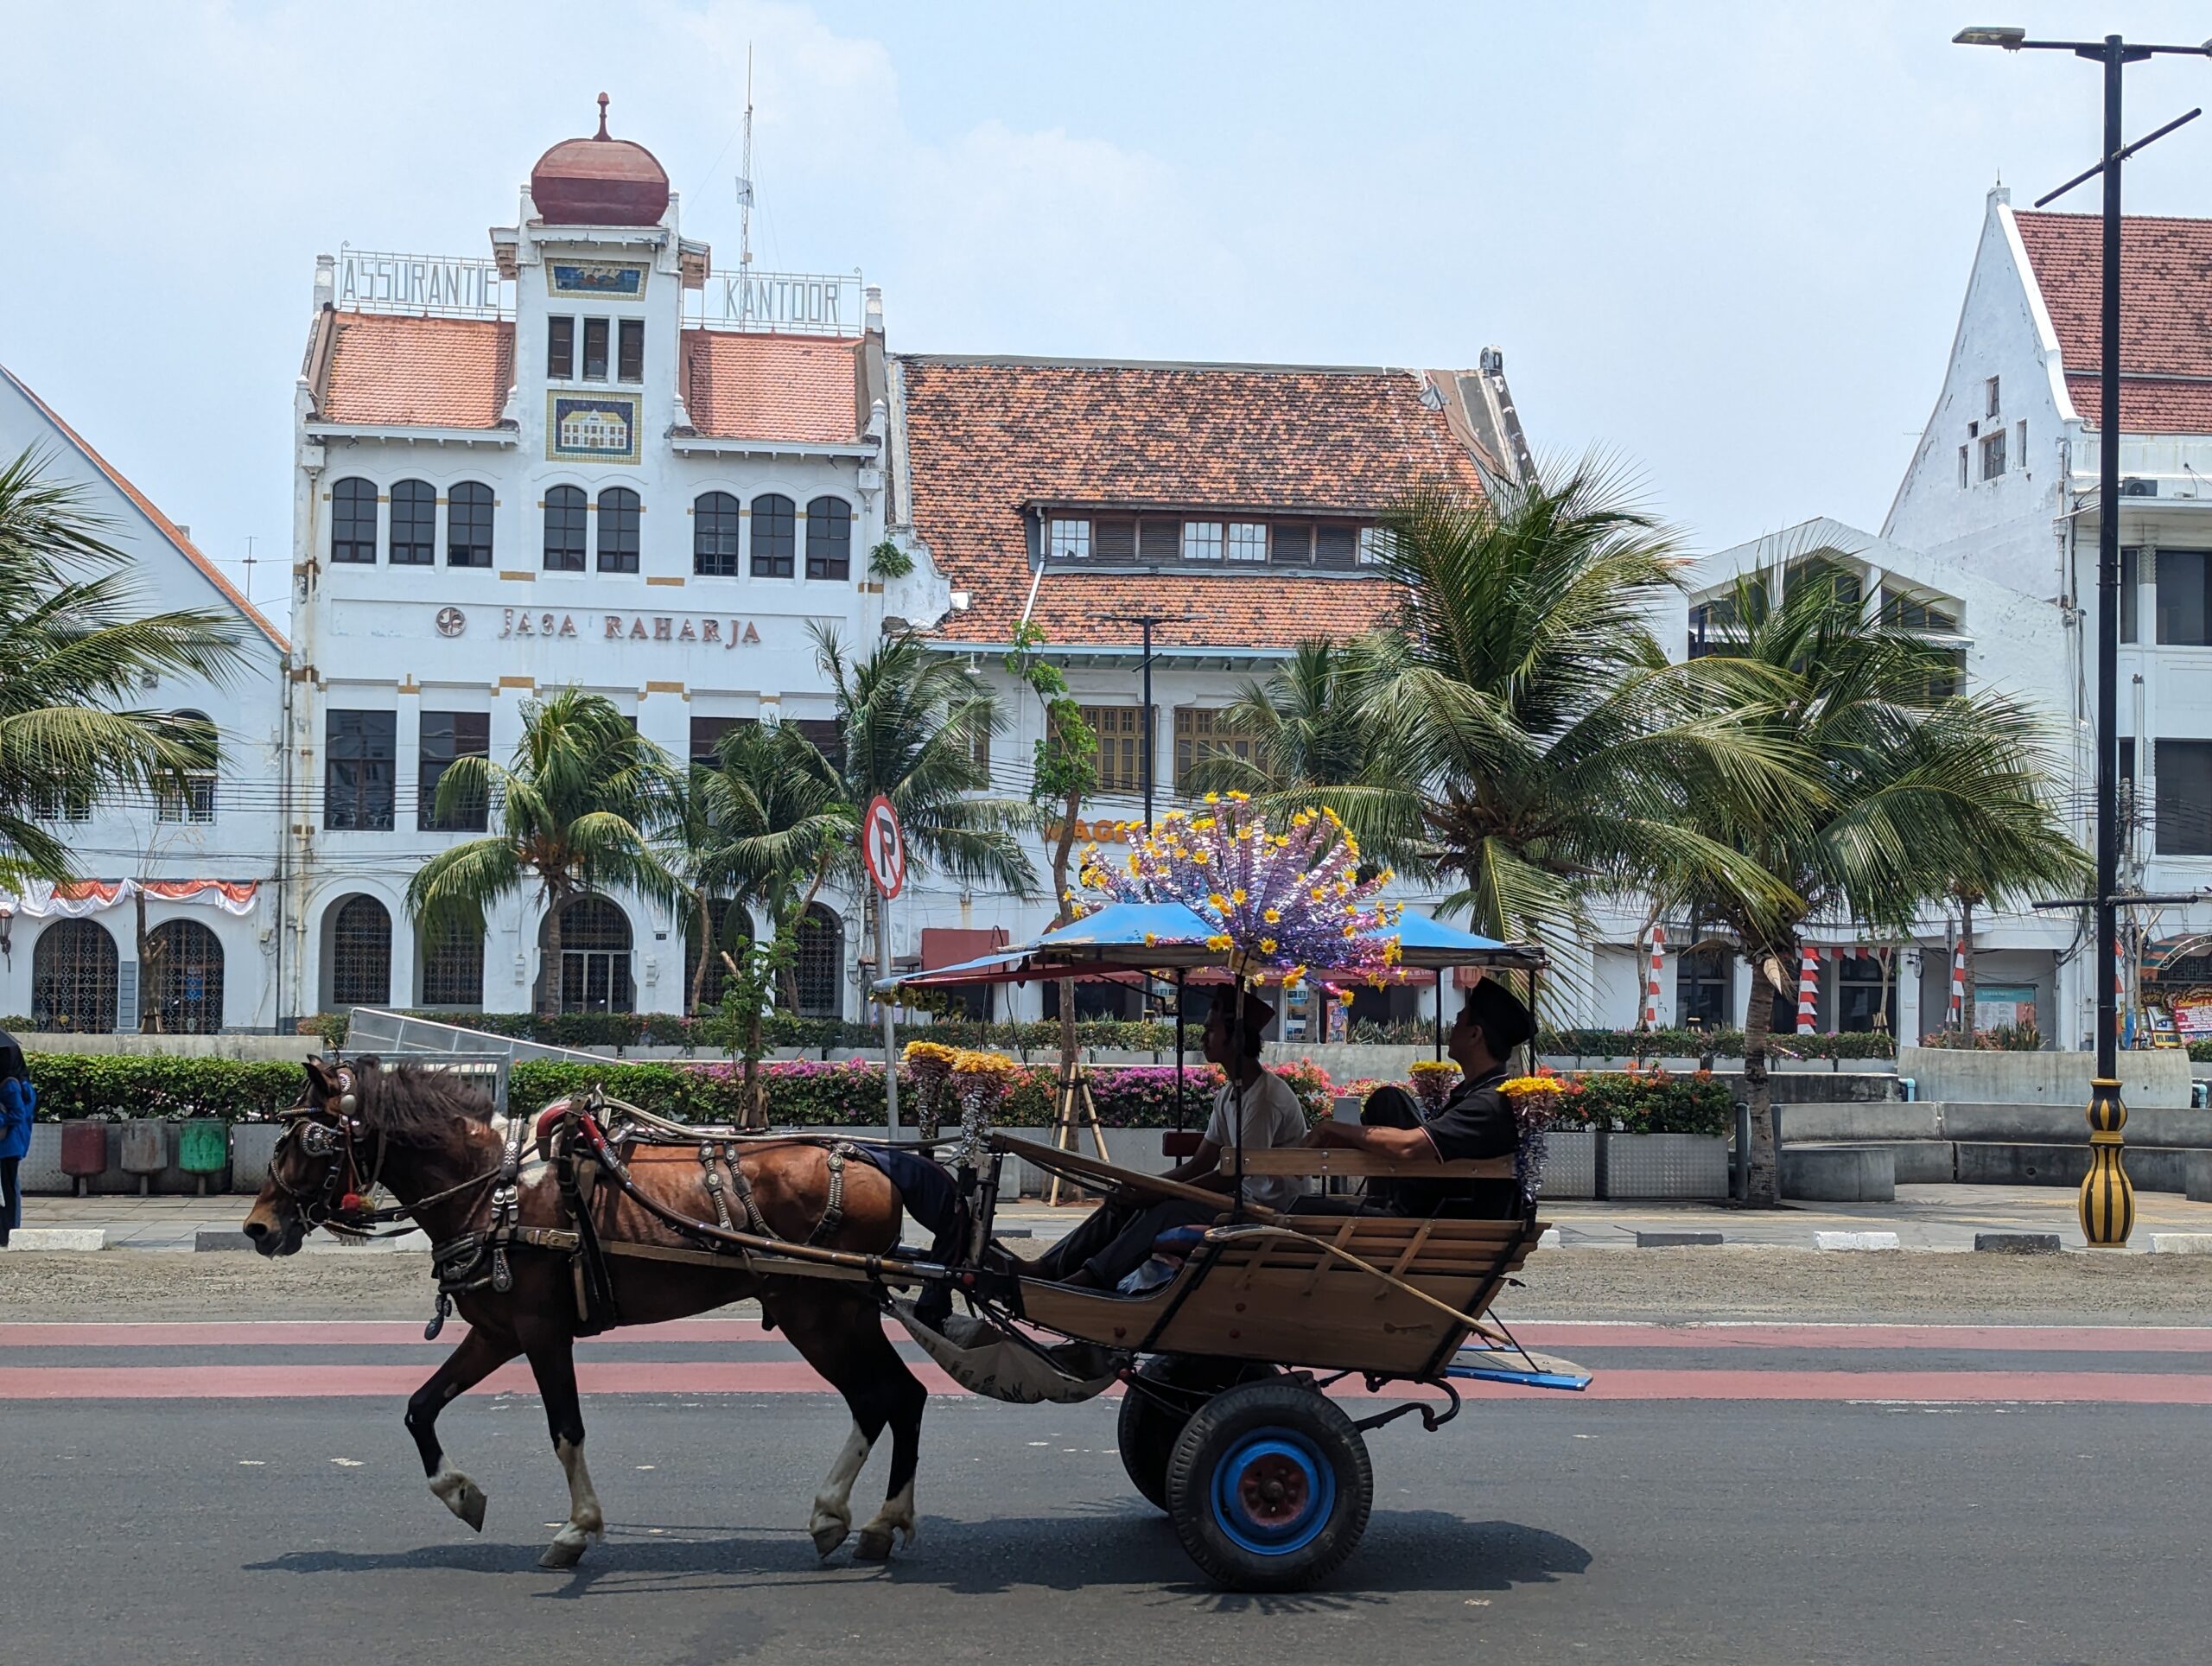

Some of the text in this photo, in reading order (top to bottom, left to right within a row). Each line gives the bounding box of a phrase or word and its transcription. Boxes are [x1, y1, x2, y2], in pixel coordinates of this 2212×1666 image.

[343, 258, 838, 323] ASSURANTIE KANTOOR
[498, 607, 761, 650] JASA RAHARJA
[879, 817, 896, 878] P
